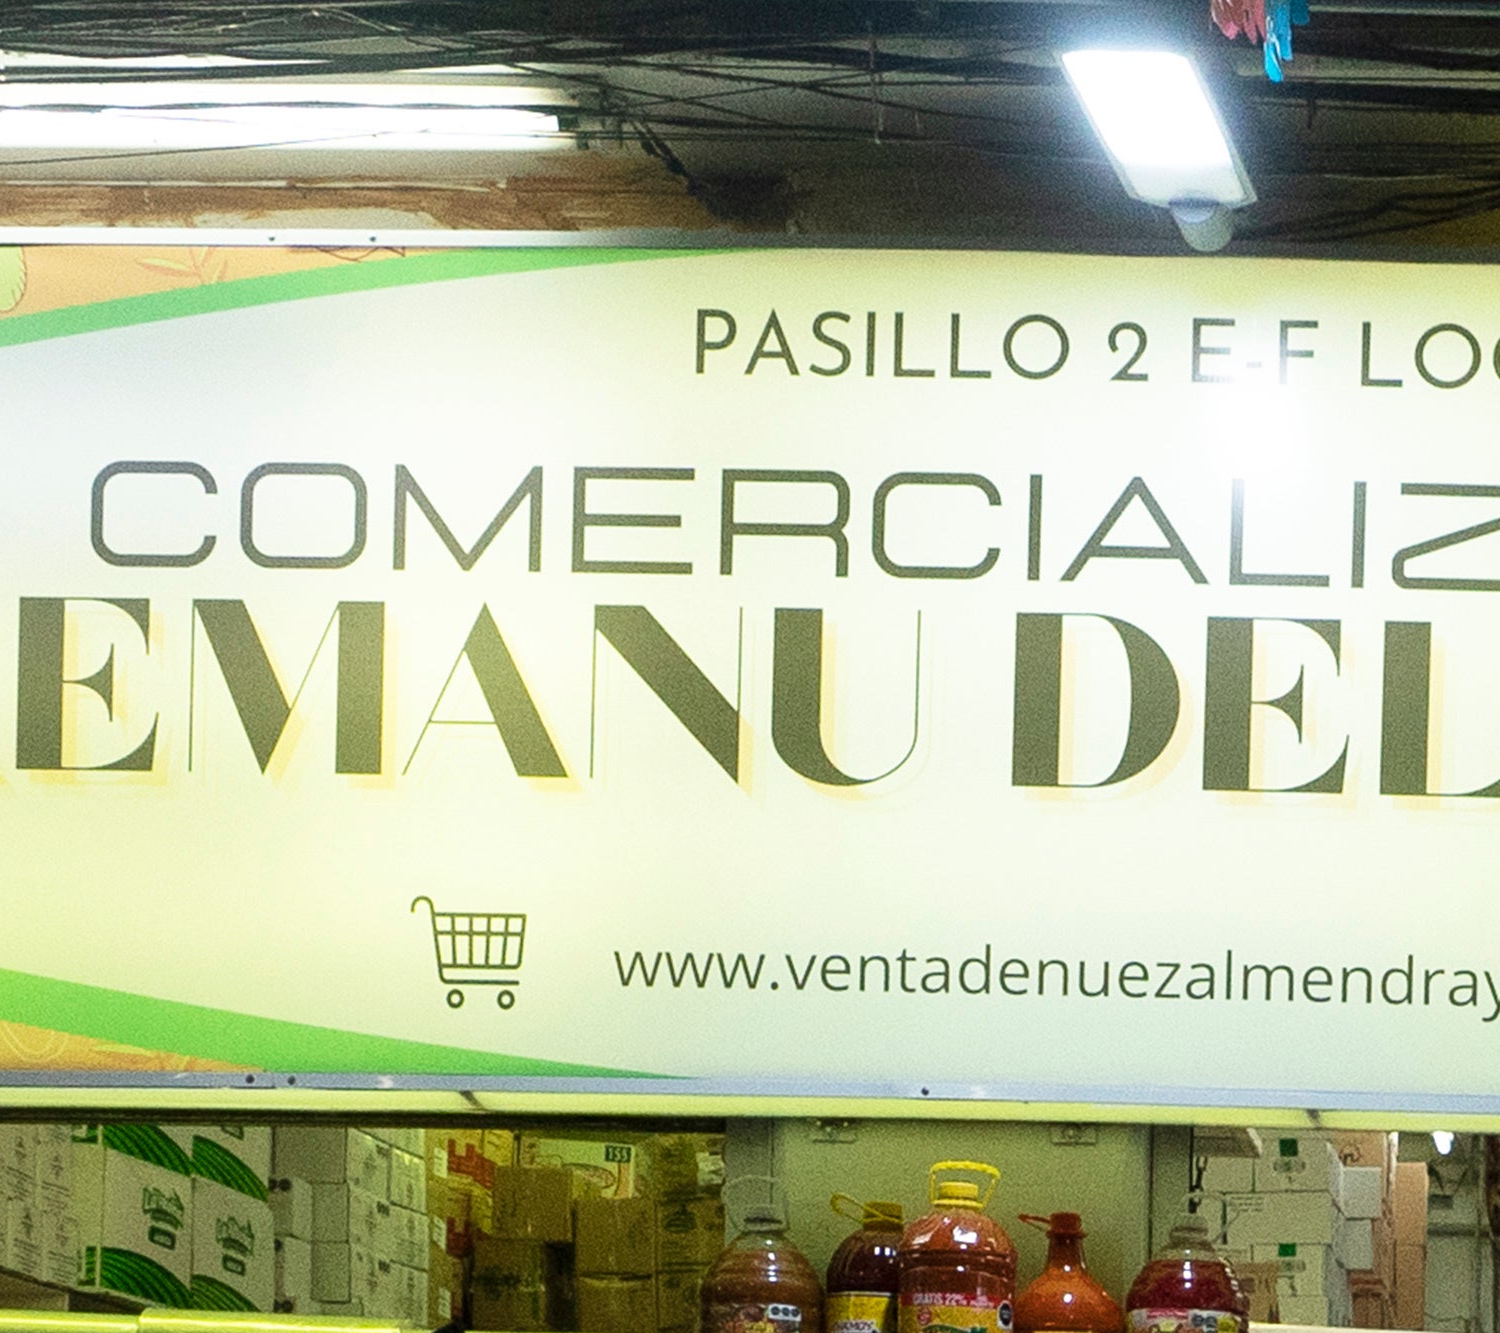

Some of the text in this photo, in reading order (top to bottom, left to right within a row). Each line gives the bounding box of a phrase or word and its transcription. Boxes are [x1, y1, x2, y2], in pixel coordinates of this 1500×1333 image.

[696, 308, 1071, 379] PASILLO
[1106, 321, 1151, 383] 2
[1190, 316, 1320, 389] E-F
